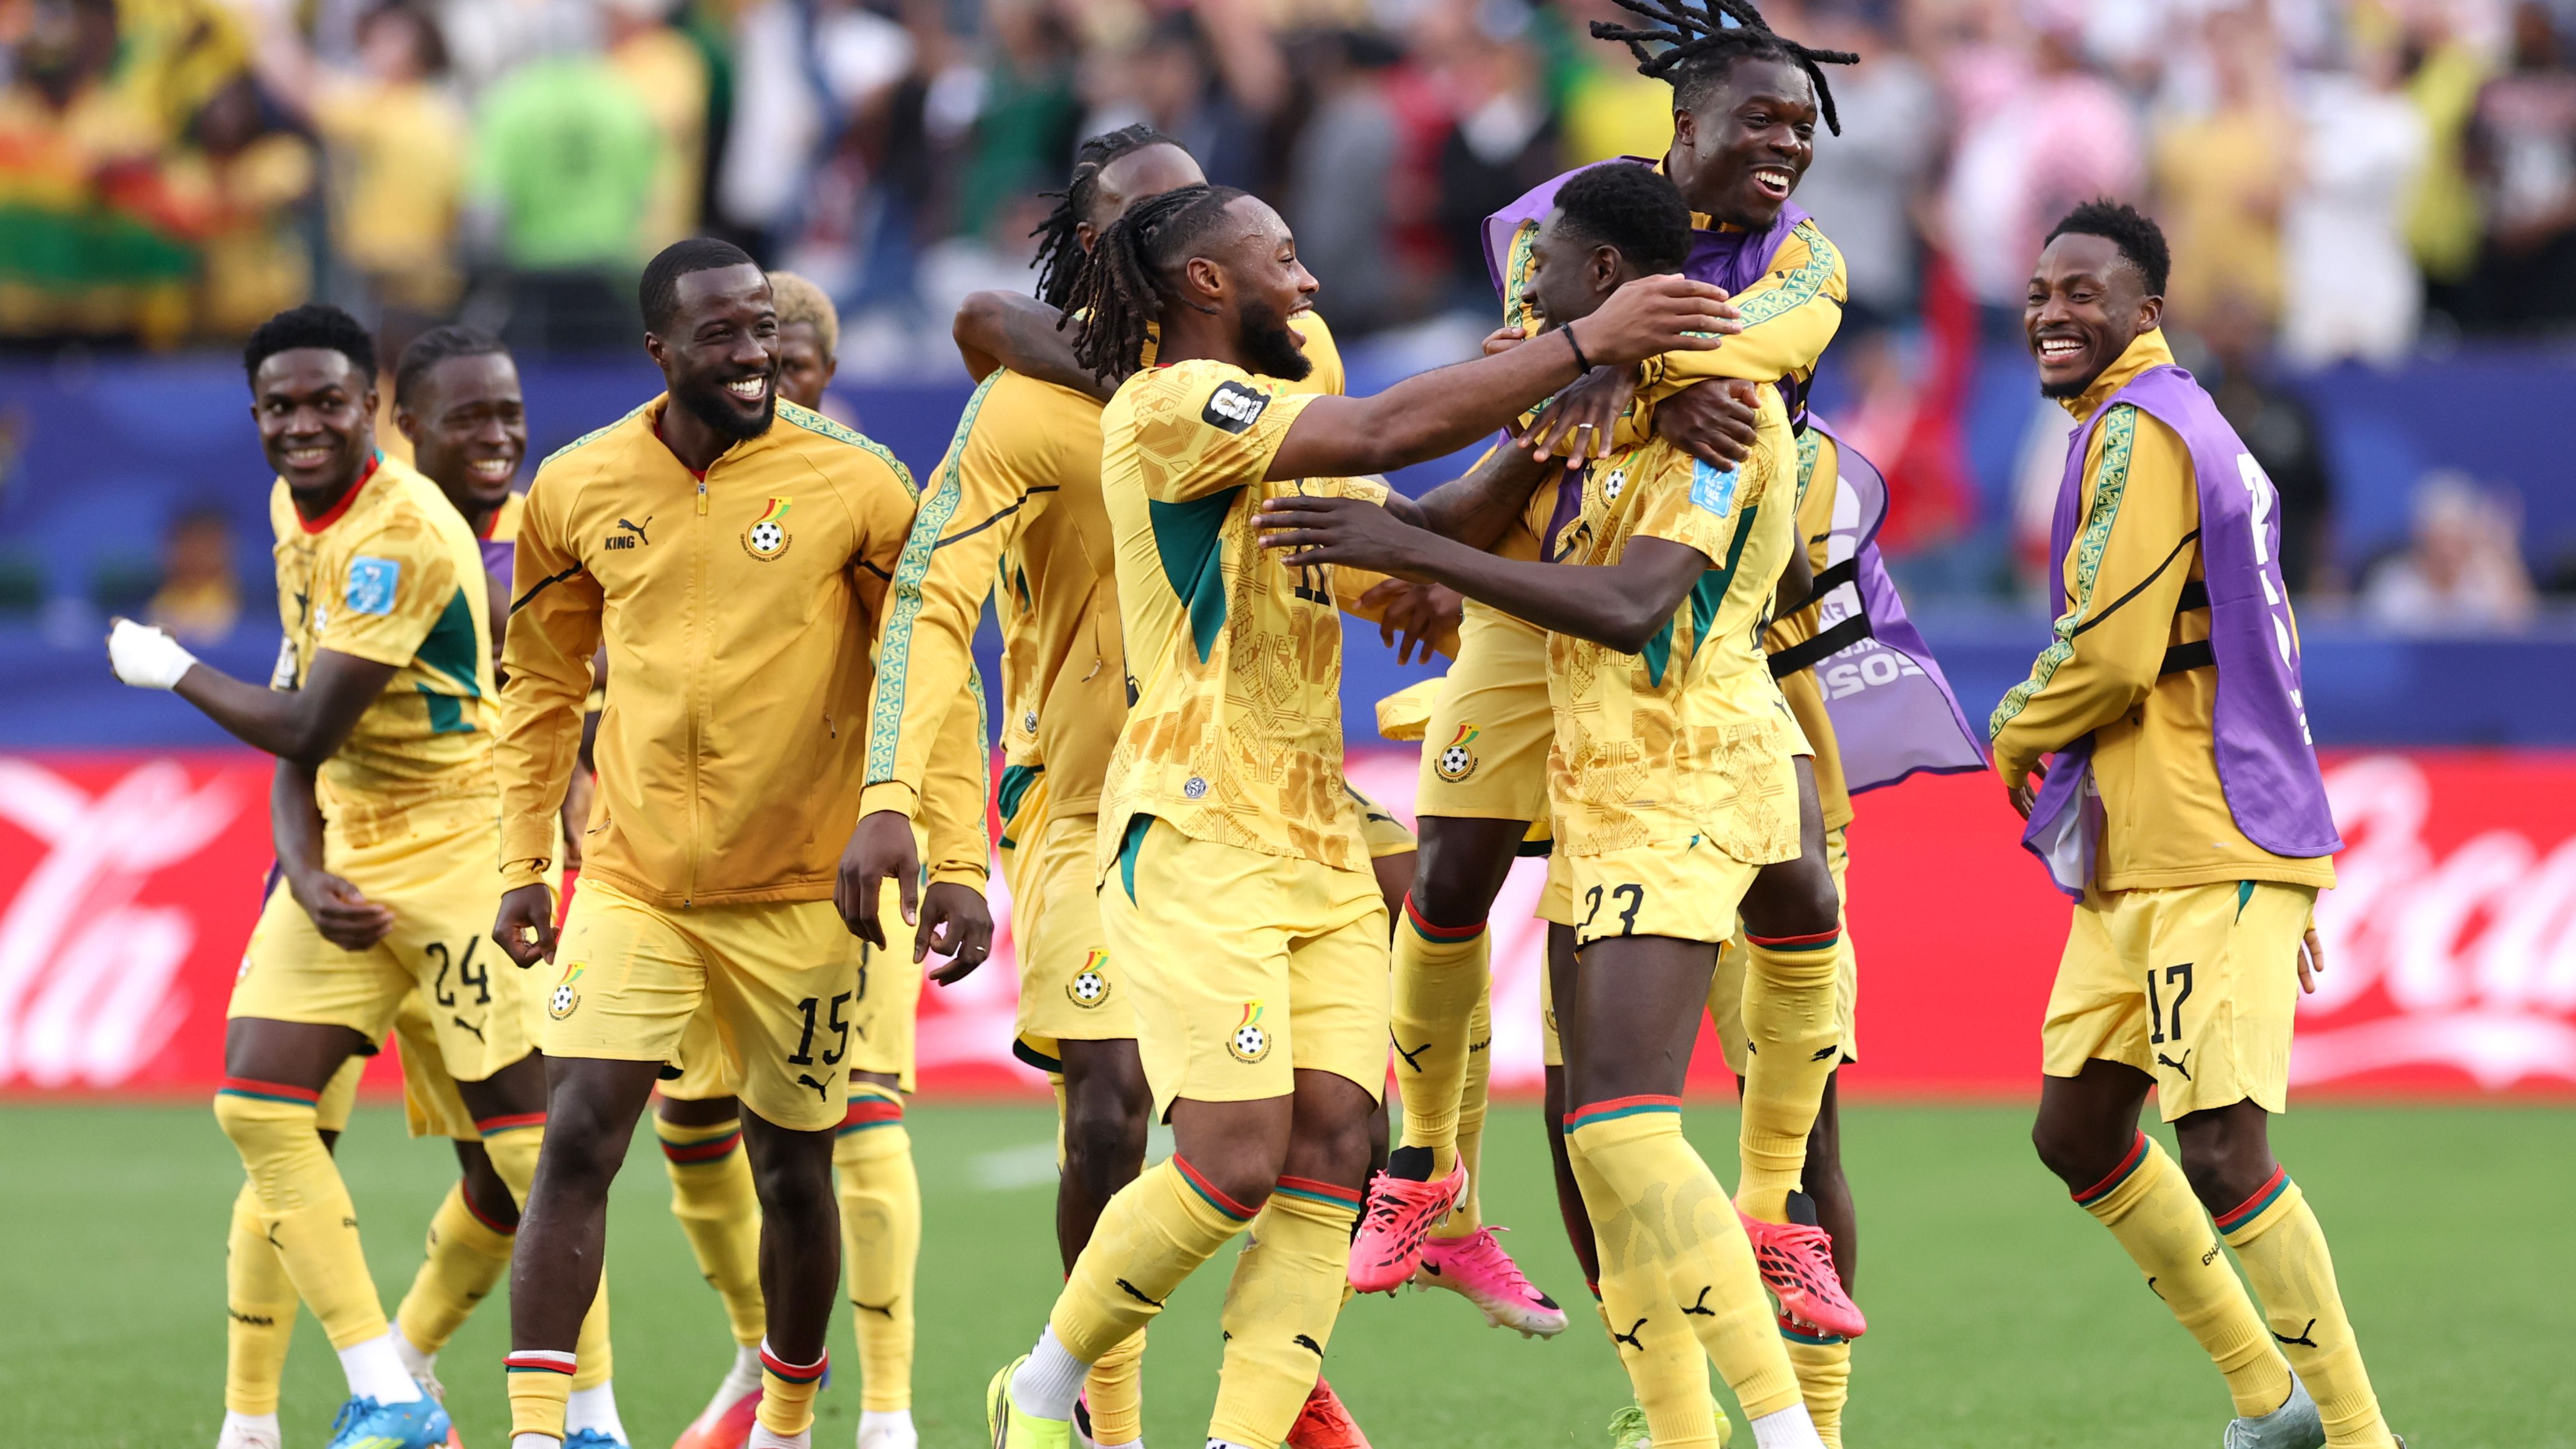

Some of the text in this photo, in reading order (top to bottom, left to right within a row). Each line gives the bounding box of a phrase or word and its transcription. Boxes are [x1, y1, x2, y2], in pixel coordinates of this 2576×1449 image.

[604, 535, 635, 551] KING
[1575, 883, 1644, 938] 23
[426, 935, 491, 1008] 24
[2148, 962, 2194, 1044] 17
[788, 990, 852, 1066] 15
